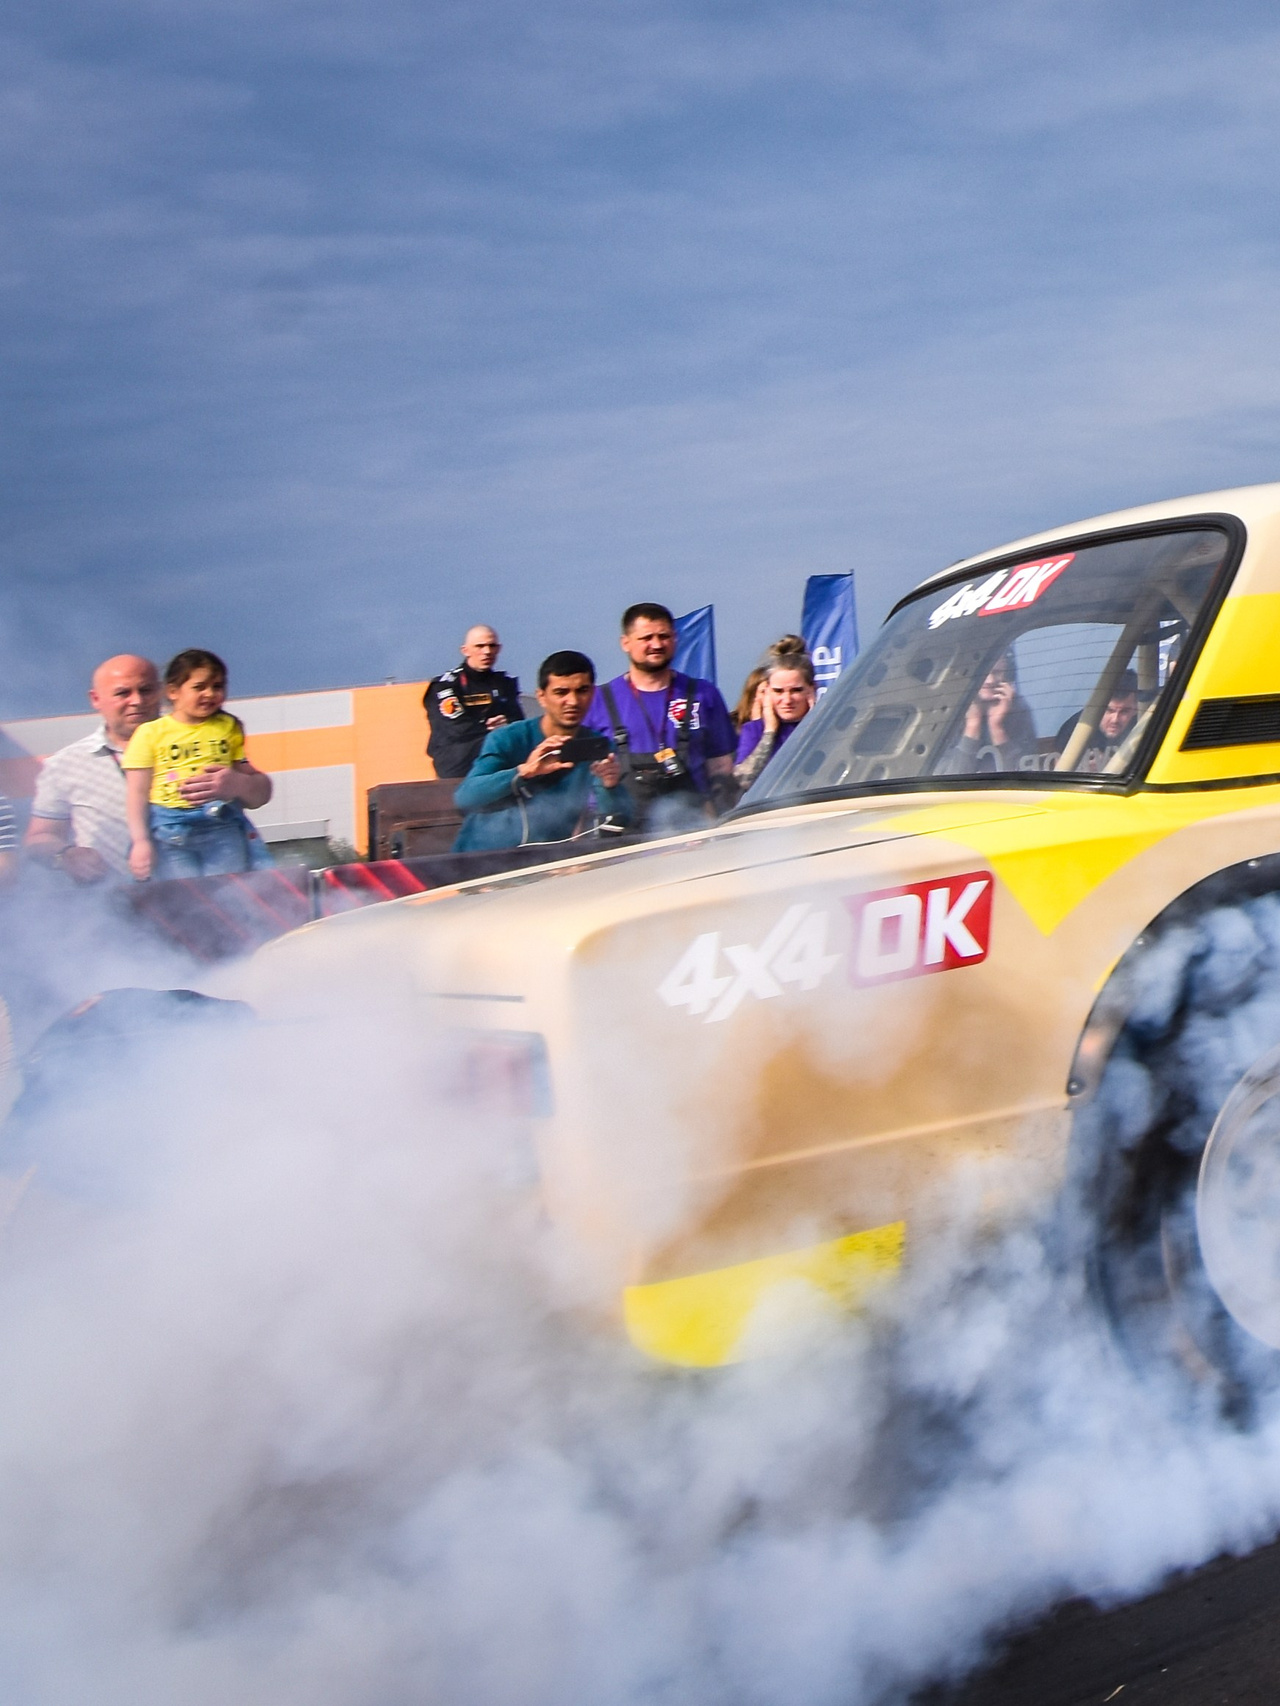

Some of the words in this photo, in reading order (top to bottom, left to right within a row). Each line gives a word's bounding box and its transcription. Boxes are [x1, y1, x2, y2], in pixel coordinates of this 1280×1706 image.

[985, 559, 1071, 610] OK
[656, 903, 843, 1024] 4x4
[857, 880, 990, 979] OK
